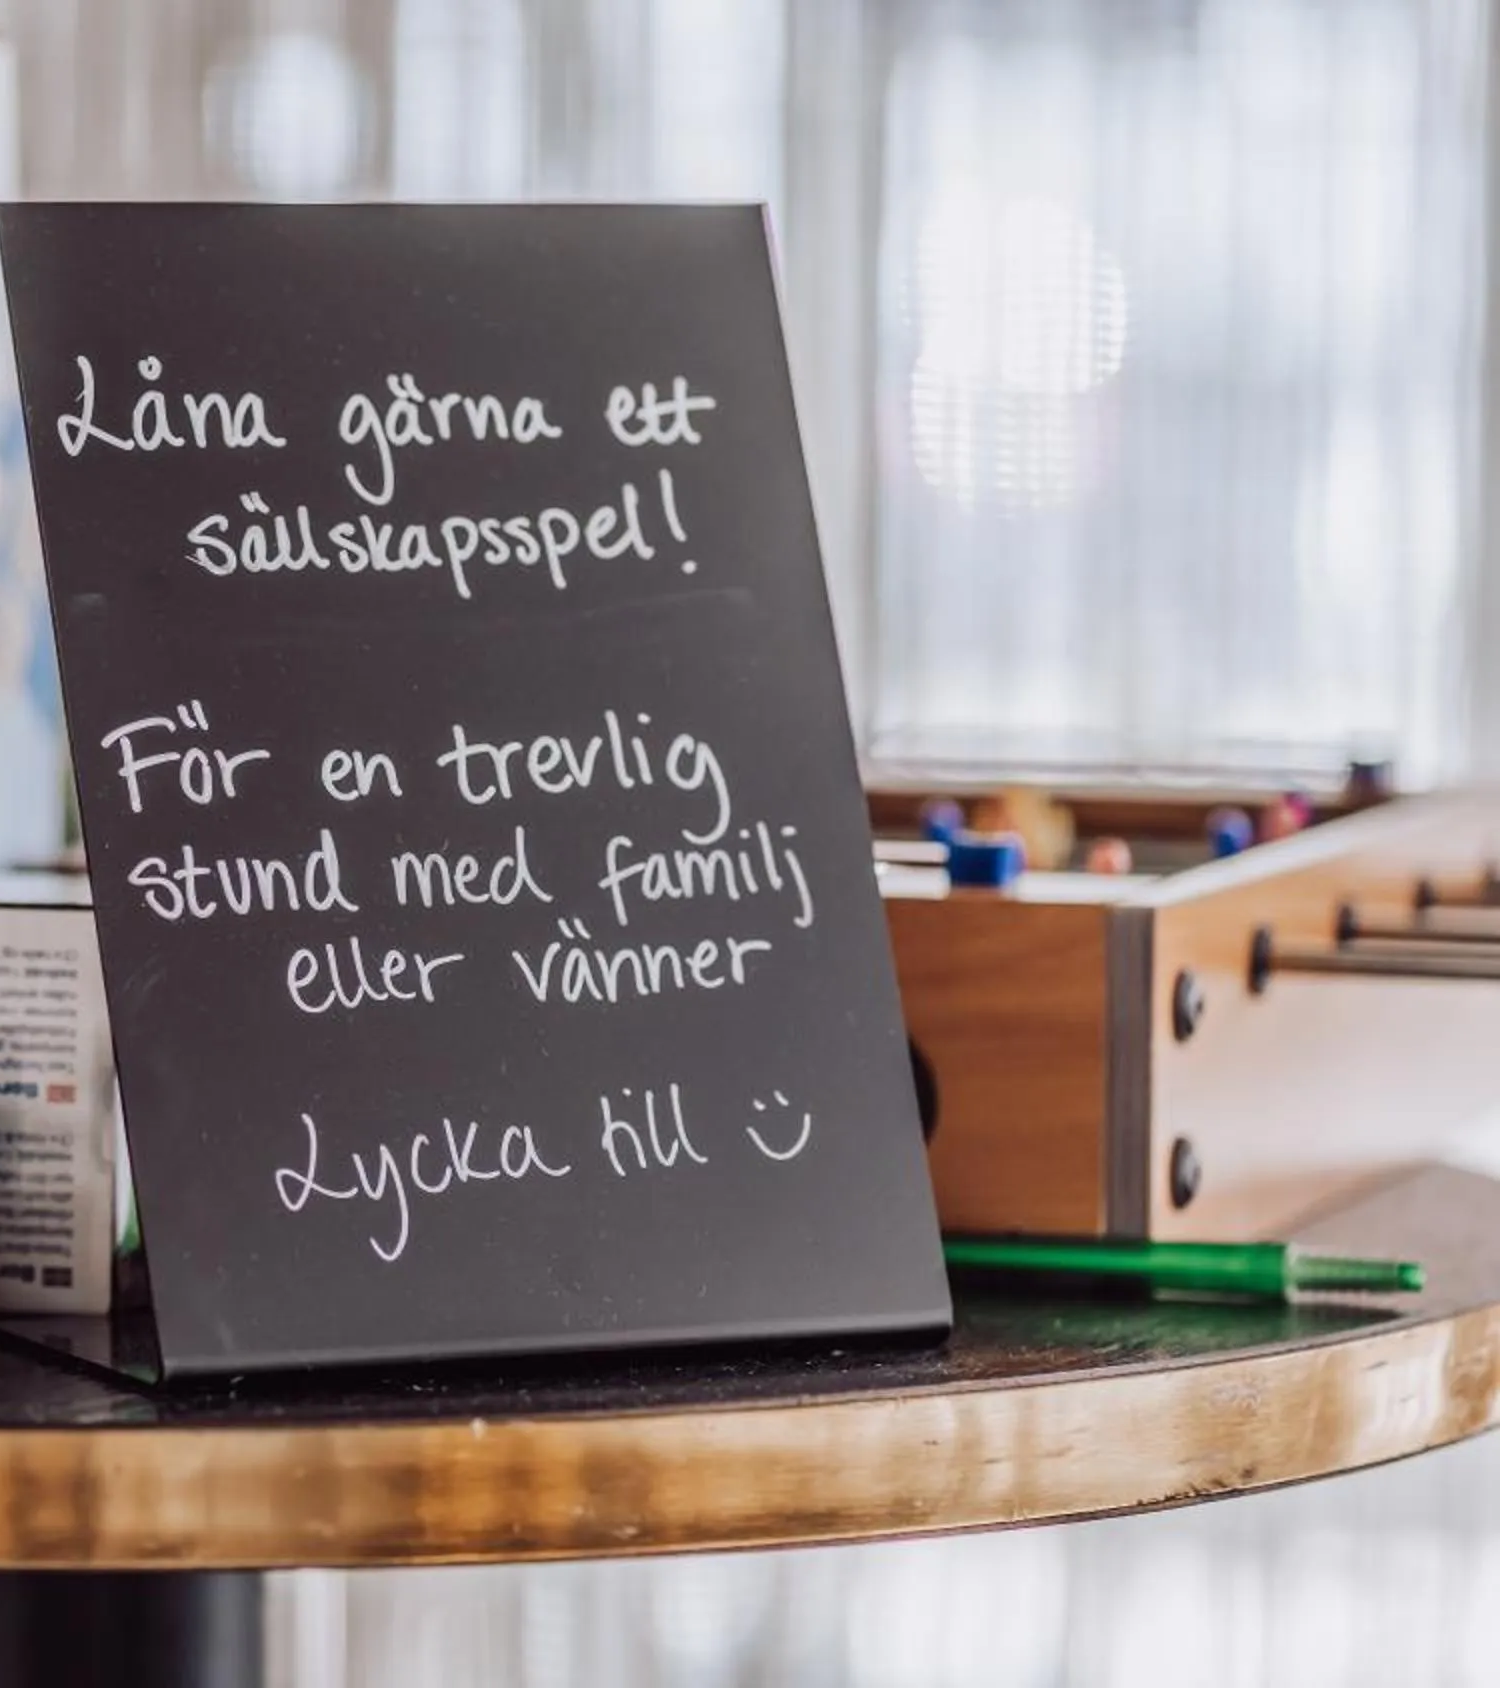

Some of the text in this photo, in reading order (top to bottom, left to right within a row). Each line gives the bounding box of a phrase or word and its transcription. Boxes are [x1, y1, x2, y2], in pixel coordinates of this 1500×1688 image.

[57, 356, 715, 505] Låna gärna ett
[185, 470, 696, 599] sällskapsspel!
[101, 700, 730, 844] För en trevlig
[128, 817, 813, 928] stund med familj
[287, 913, 771, 1013] eller vänner
[275, 1084, 708, 1261] Lycka till
